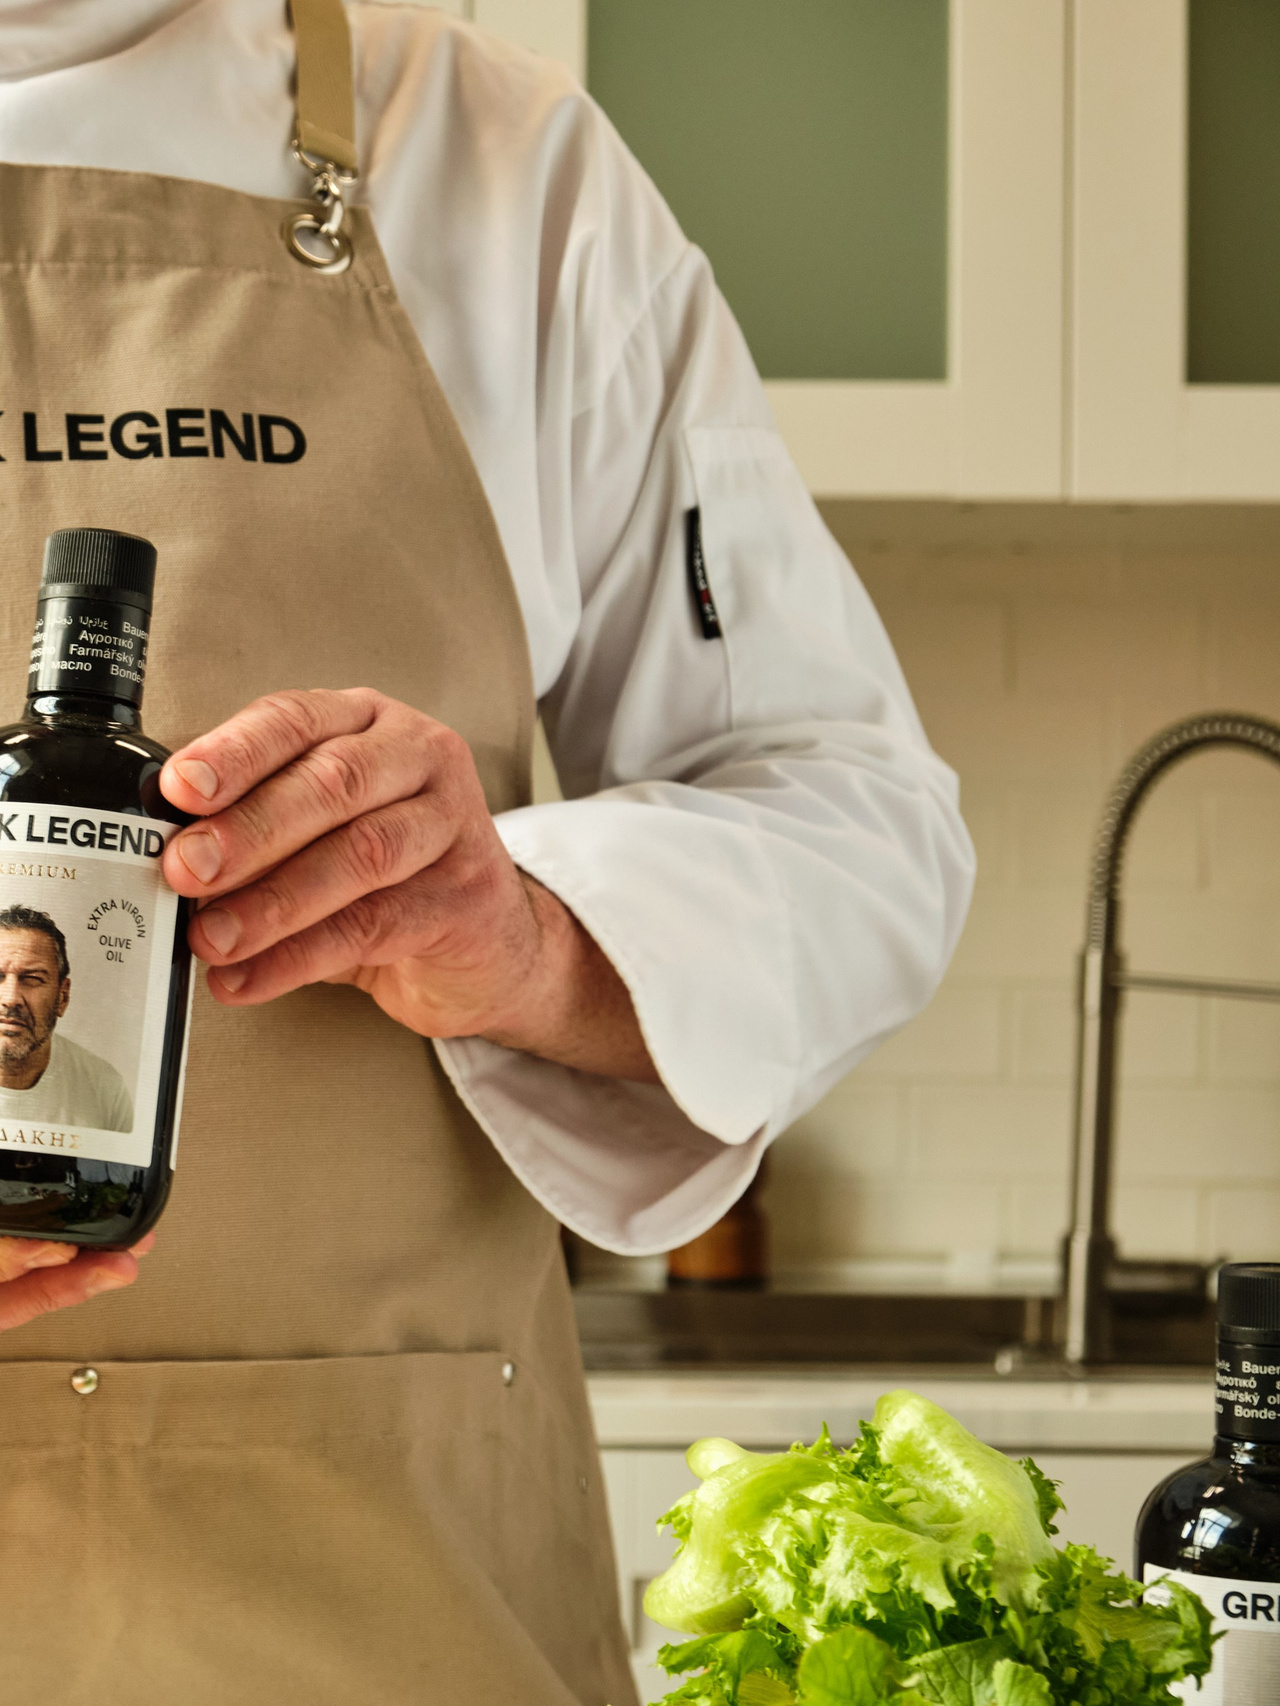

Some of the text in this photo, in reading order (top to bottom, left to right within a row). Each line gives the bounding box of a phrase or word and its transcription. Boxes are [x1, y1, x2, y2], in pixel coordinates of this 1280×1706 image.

[23, 407, 308, 465] LEGEND
[79, 629, 134, 649] Αγροτικό
[69, 643, 135, 666] Farmářský
[51, 660, 93, 672] масло
[26, 814, 165, 858] LEGEND
[87, 899, 146, 938] EXTRA VIRGIN
[99, 934, 132, 950] OLIVE
[106, 950, 124, 963] OIL
